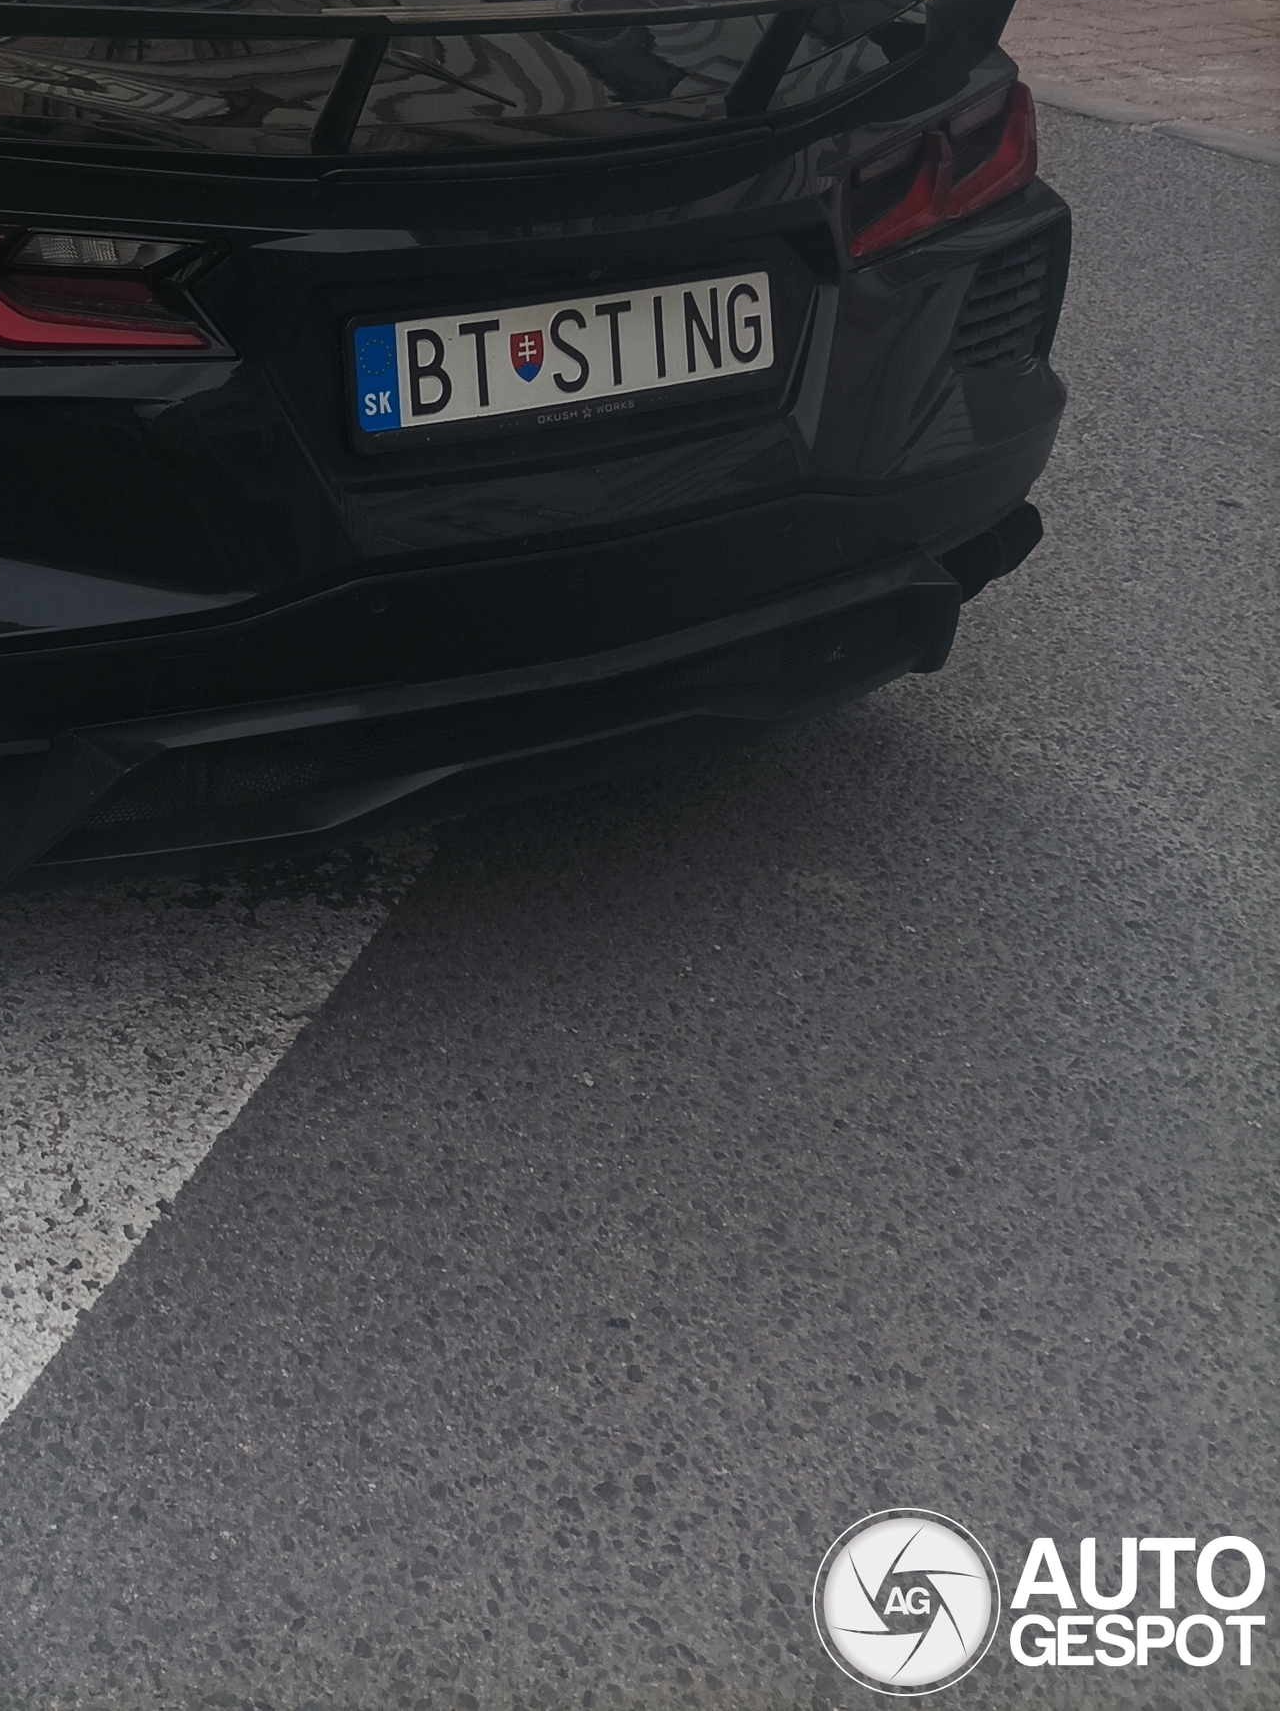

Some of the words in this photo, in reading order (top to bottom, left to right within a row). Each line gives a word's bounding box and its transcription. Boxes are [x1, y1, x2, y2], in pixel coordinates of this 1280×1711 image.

[406, 319, 500, 417] BT
[550, 283, 763, 393] STING
[364, 390, 393, 416] SK
[537, 410, 579, 425] OKUSH
[596, 399, 635, 414] WORKS
